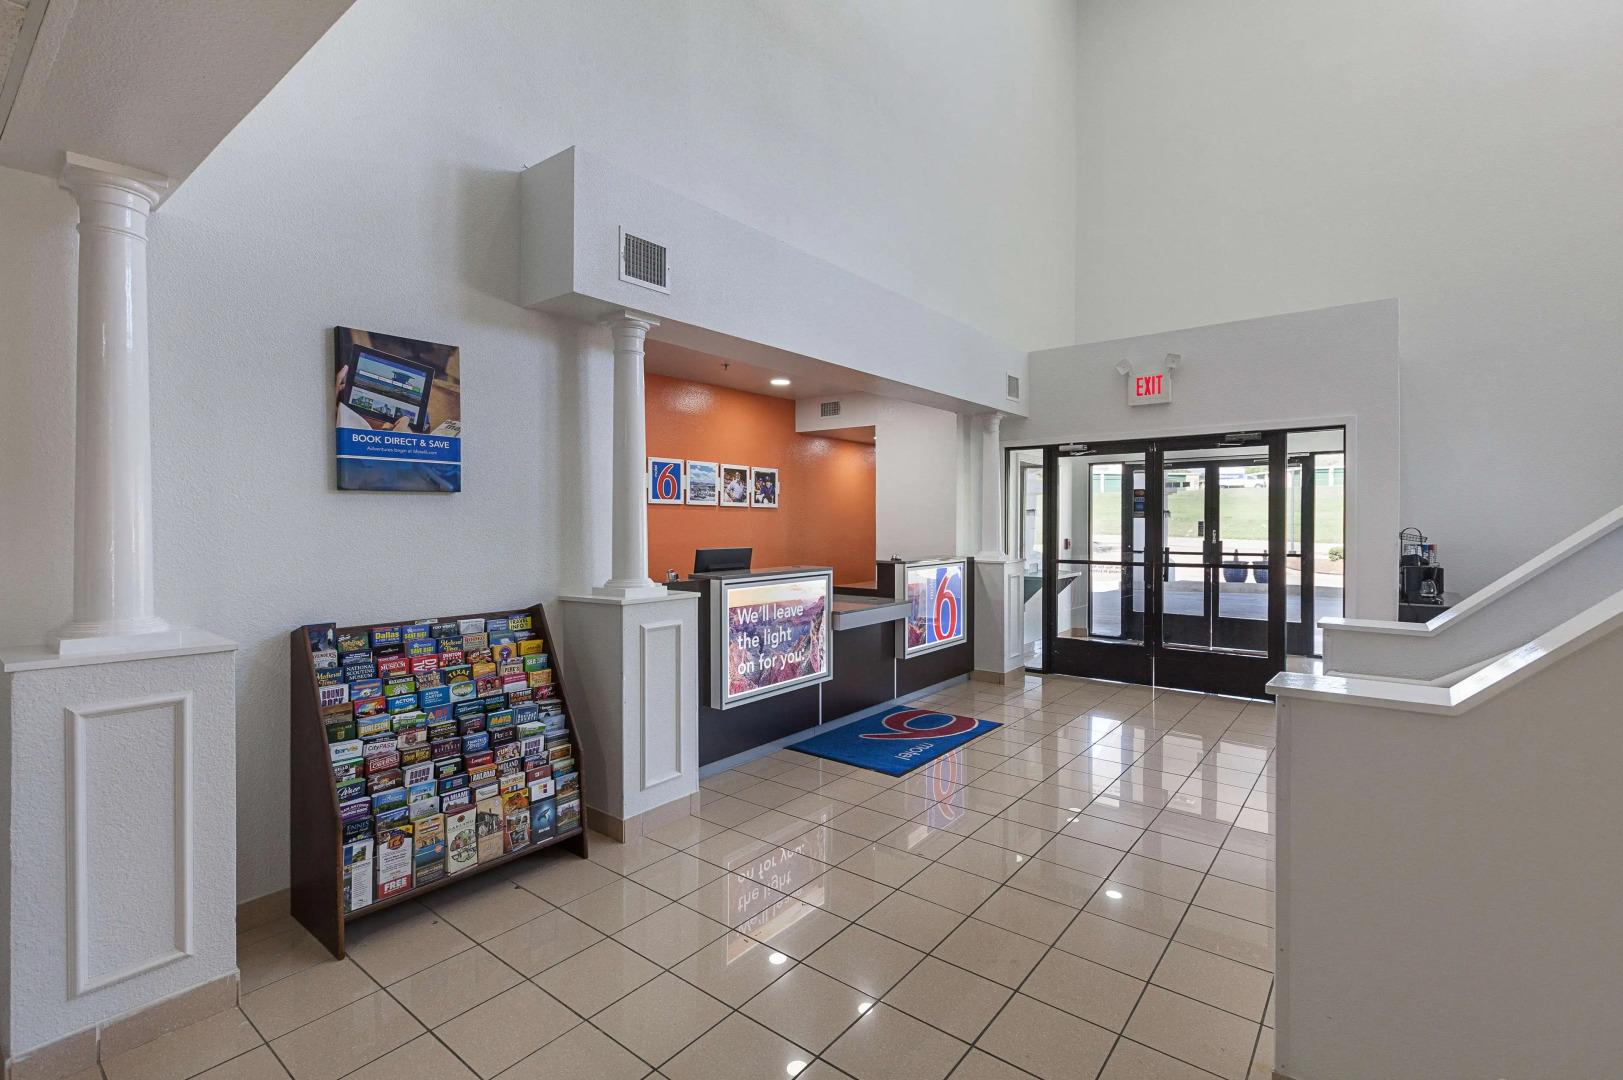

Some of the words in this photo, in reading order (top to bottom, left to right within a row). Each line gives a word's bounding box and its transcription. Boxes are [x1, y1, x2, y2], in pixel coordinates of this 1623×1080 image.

[1136, 374, 1163, 397] EXIT
[352, 433, 382, 444] BOOK
[384, 436, 417, 446] DIRECT
[419, 439, 427, 447] &
[428, 439, 450, 449] SAVE
[366, 445, 393, 453] Adventures
[656, 463, 678, 500] 6
[933, 567, 958, 641] 6
[737, 604, 769, 625] We'll
[773, 603, 804, 620] leave
[375, 631, 399, 640] Dallas
[737, 631, 760, 650] the
[763, 626, 792, 648] light
[346, 664, 375, 672] NATIONAL
[380, 660, 406, 671] MUSEUM
[737, 660, 754, 675] on
[758, 653, 777, 671] for
[316, 670, 342, 680] Medieval
[346, 669, 375, 677] SCOUTING
[448, 669, 470, 678] TEXAS
[321, 688, 344, 699] ROUND
[427, 708, 449, 719] ART
[490, 714, 512, 725] MAYA
[361, 721, 388, 733] BURLESON
[858, 709, 979, 740] 6
[367, 743, 395, 752] CityPASS
[894, 742, 934, 761] motel
[410, 767, 430, 779] ROUND
[472, 769, 496, 782] RAILROAD
[450, 790, 468, 800] MIAMI
[346, 819, 370, 832] ENNIS
[384, 877, 407, 893] FREE
